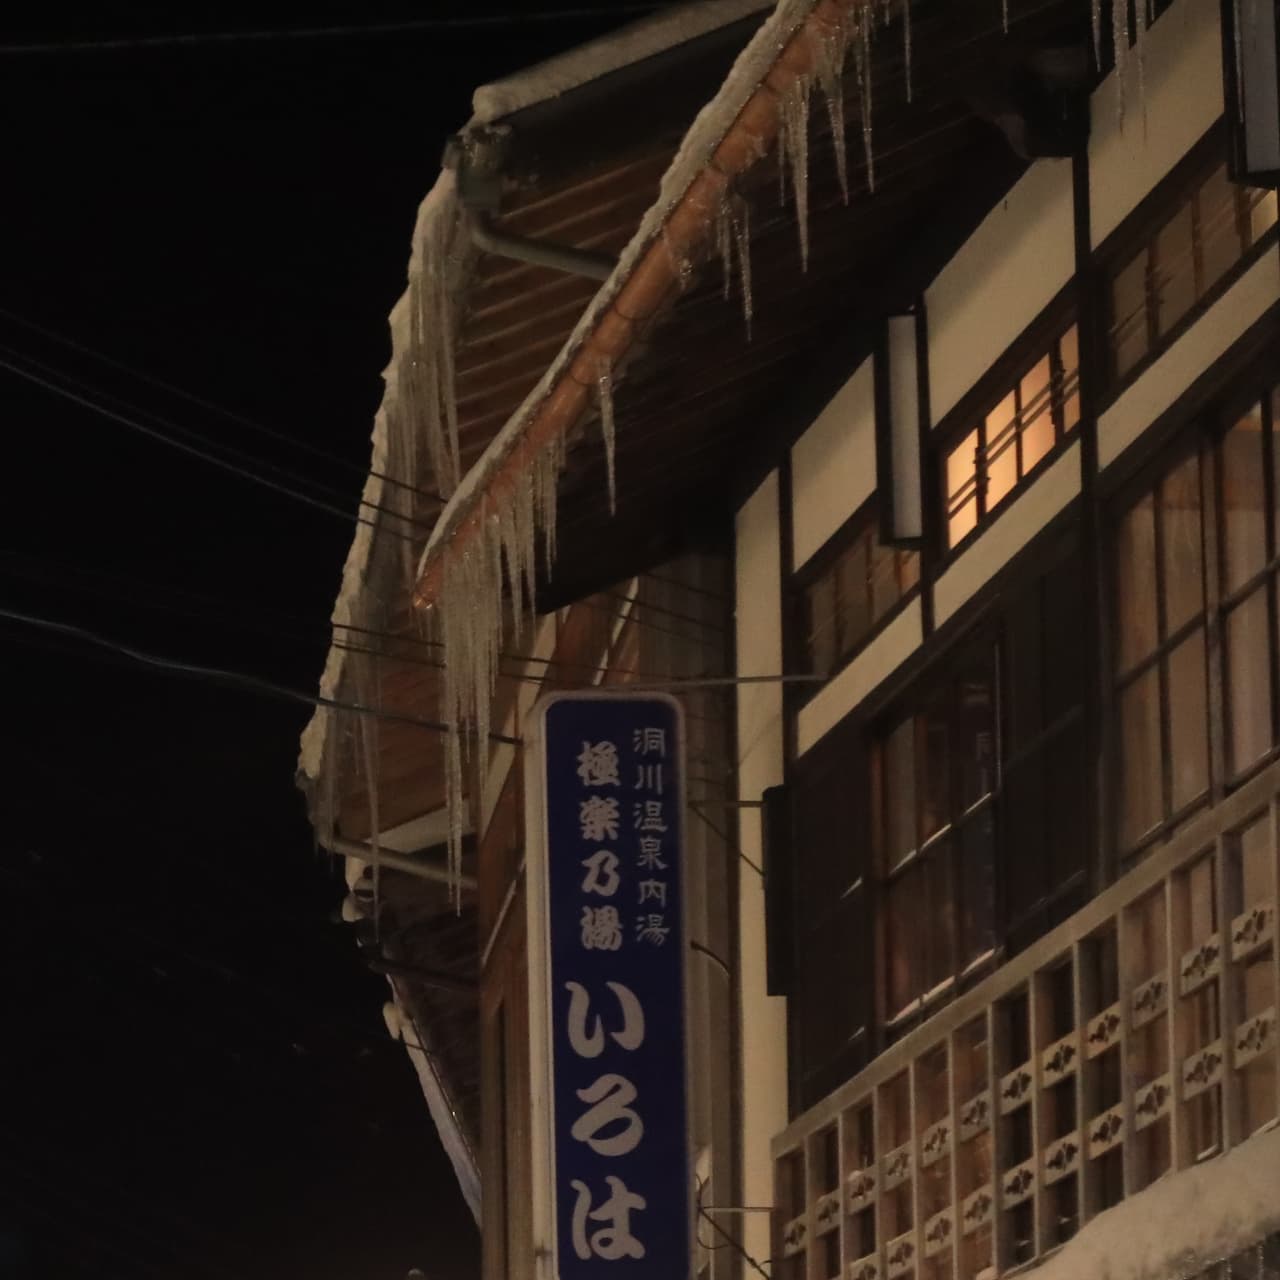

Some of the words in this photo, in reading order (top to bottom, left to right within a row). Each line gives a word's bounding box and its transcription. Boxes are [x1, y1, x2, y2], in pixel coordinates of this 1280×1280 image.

[576, 740, 624, 951] 極楽乃湯
[633, 727, 670, 946] 洞川温泉内湯
[565, 981, 646, 1261] いろは
